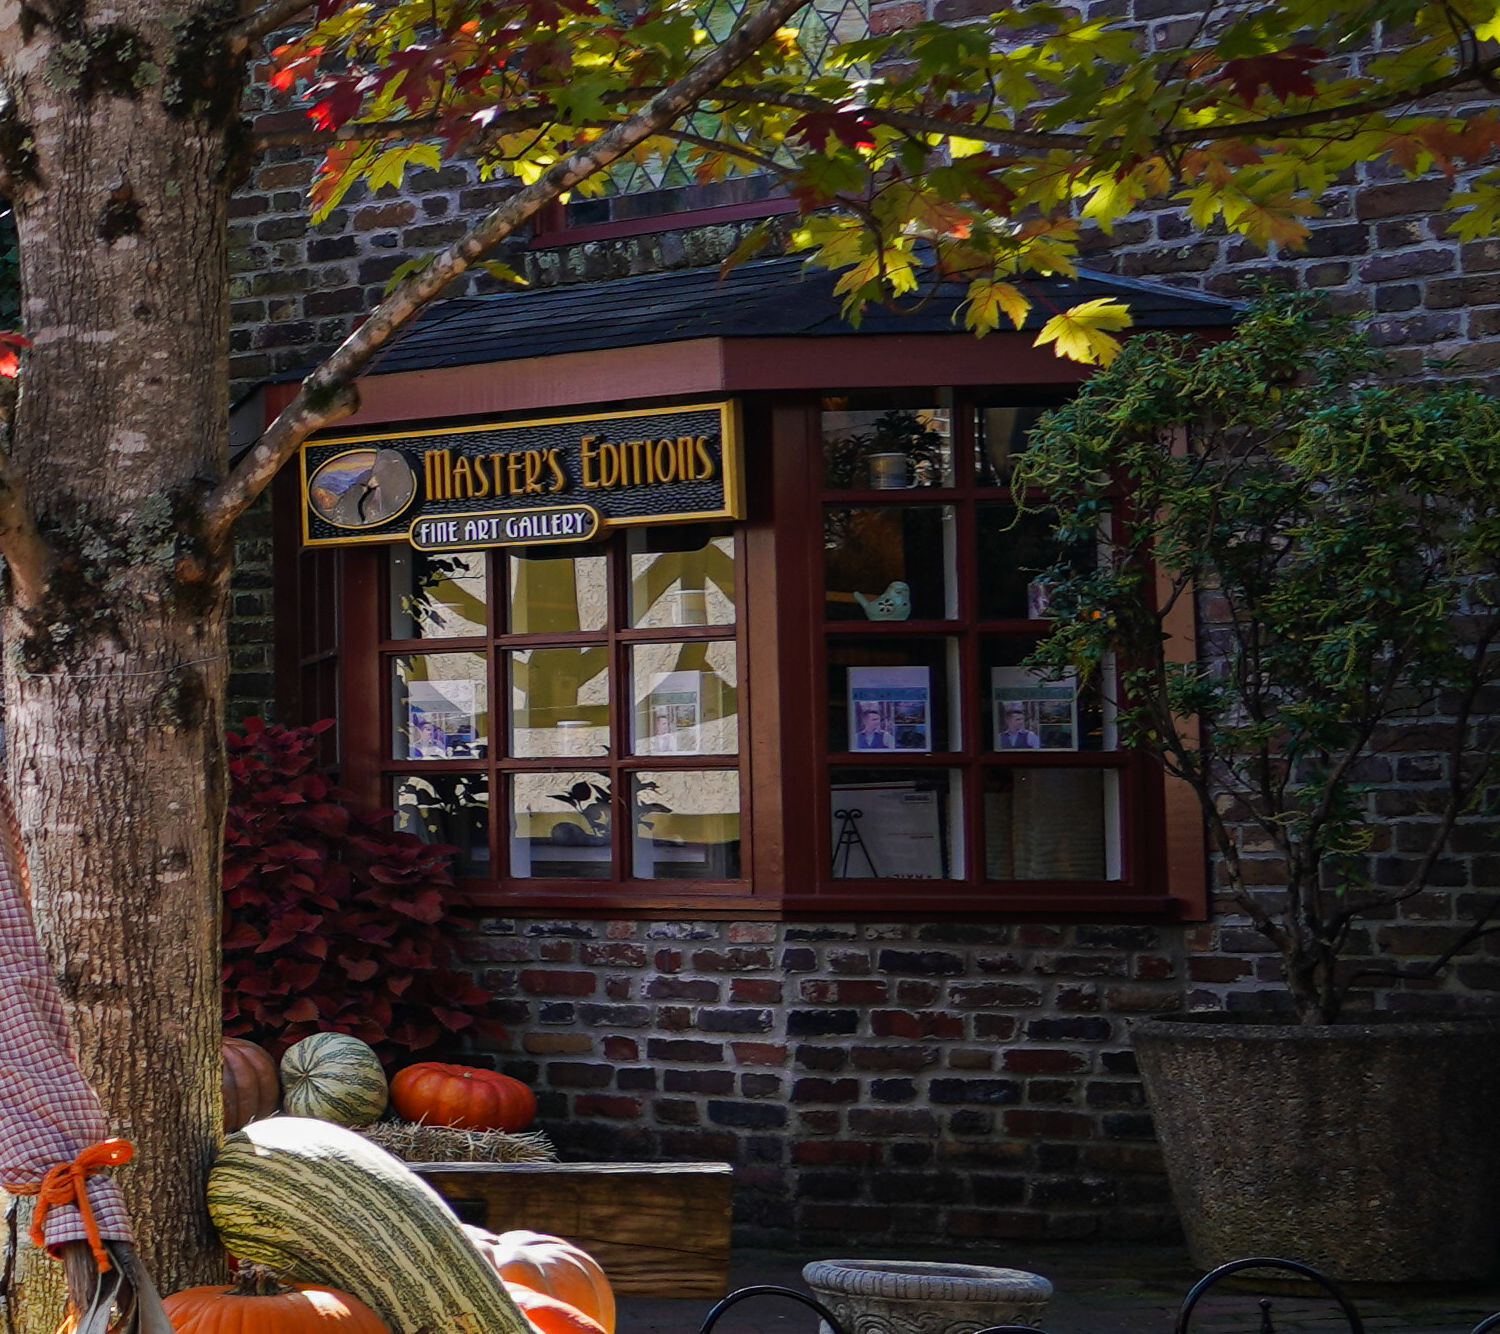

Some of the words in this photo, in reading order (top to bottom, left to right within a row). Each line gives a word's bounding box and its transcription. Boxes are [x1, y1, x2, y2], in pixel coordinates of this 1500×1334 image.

[424, 448, 567, 501] MASTER'S
[581, 435, 715, 490] EDITIONS
[420, 522, 459, 544] FINE
[464, 518, 500, 541] ART
[506, 512, 588, 538] GALLERY
